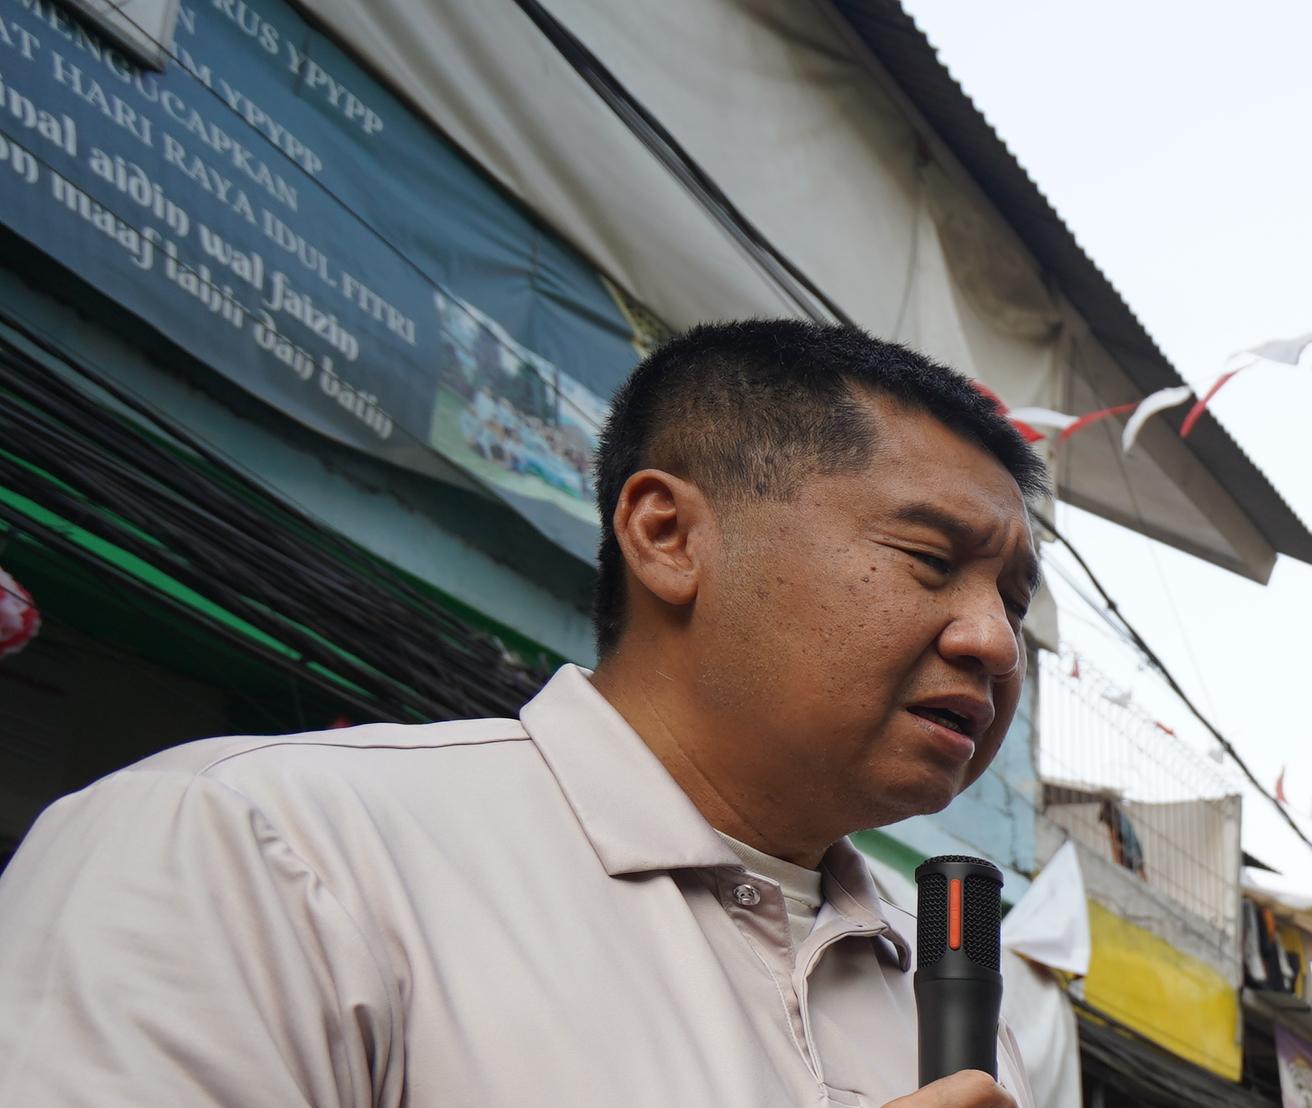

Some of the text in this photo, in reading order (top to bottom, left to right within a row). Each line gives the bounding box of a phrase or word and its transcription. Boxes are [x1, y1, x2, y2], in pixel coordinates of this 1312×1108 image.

[50, 171, 162, 271] maaf
[165, 240, 243, 329] lahir
[254, 307, 314, 381] dan
[320, 354, 392, 441] batin
[52, 51, 154, 148] HARI
[163, 131, 257, 225] RAYA
[263, 207, 338, 288] IDUL
[342, 271, 416, 346] FITRI
[88, 147, 190, 238] aidin
[199, 222, 265, 291] wal
[261, 271, 359, 362] faizin
